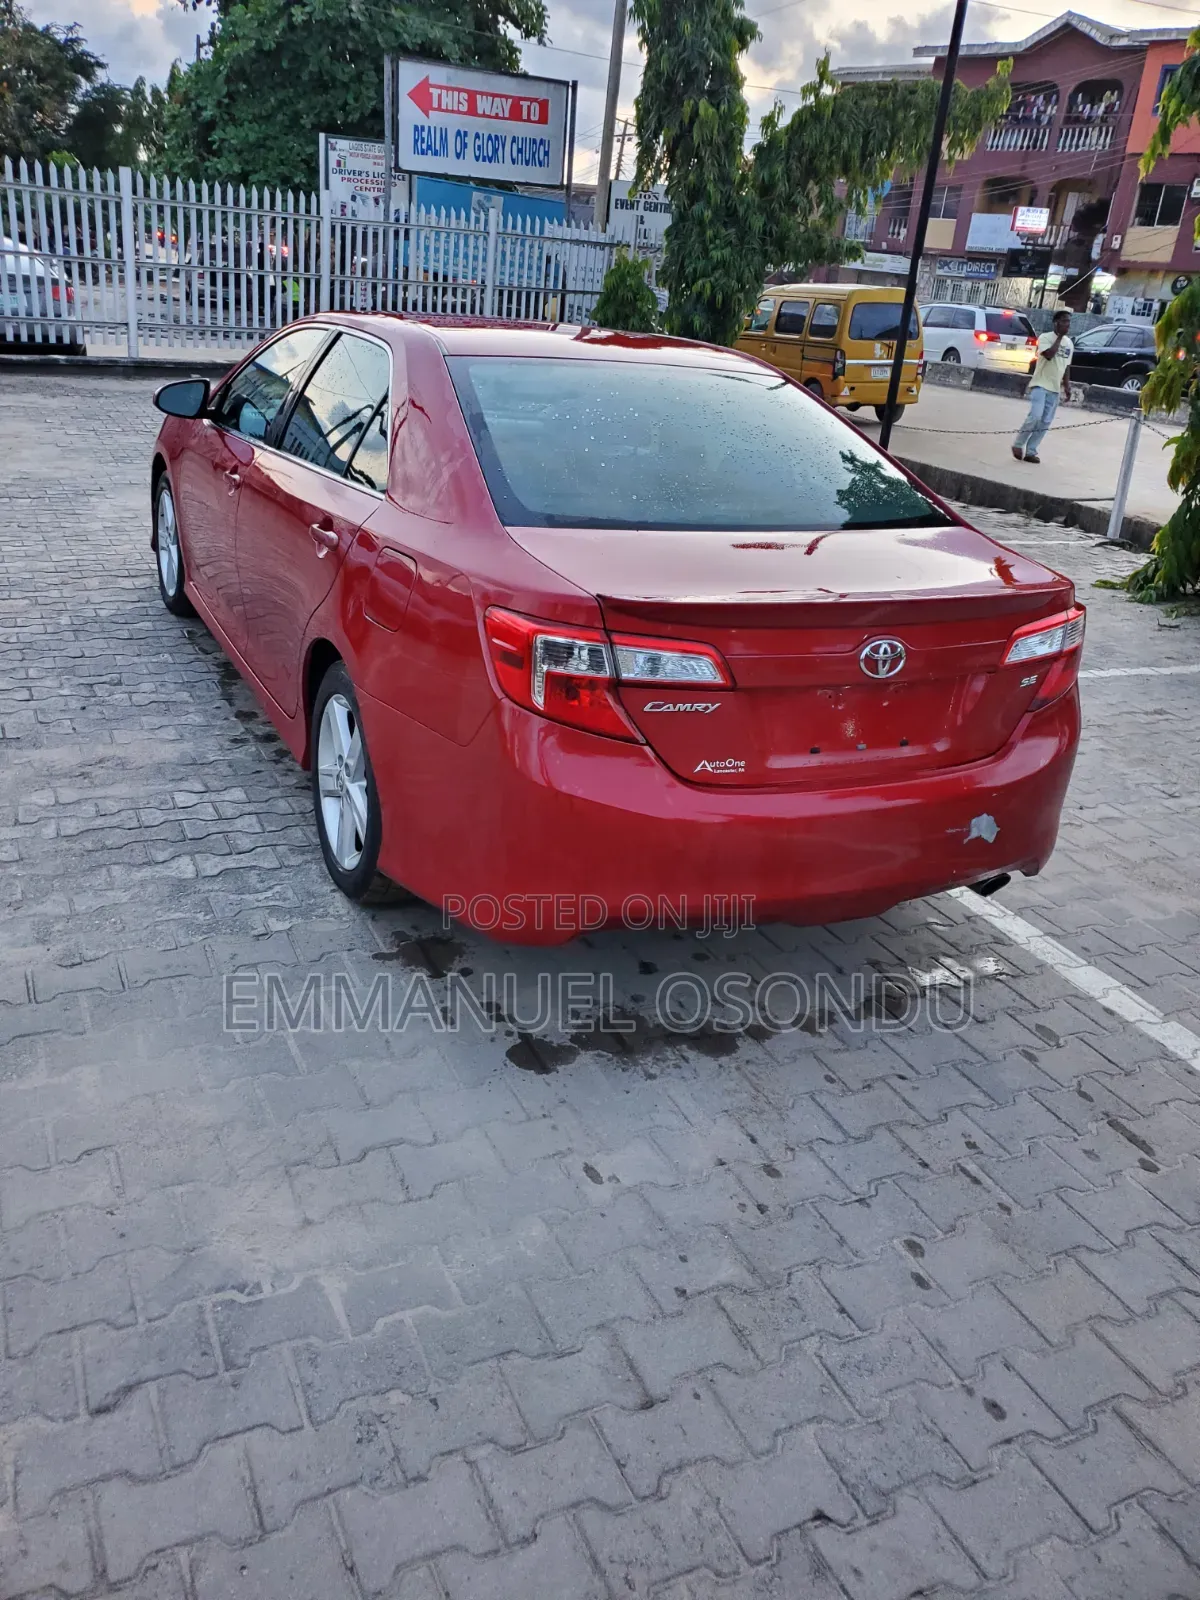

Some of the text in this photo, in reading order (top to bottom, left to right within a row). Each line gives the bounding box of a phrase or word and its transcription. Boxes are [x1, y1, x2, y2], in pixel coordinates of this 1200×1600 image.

[429, 87, 540, 121] THIS WAY TO
[413, 124, 551, 168] REALM OF GLORY CHURCH
[332, 167, 407, 181] DRIVER'S LICNCE
[341, 176, 398, 188] PROCESSIG
[614, 197, 640, 211] EVENT
[966, 261, 997, 273] DIRECT
[1020, 674, 1038, 688] SE
[643, 701, 722, 714] CAMRY
[693, 758, 746, 773] AutoOne
